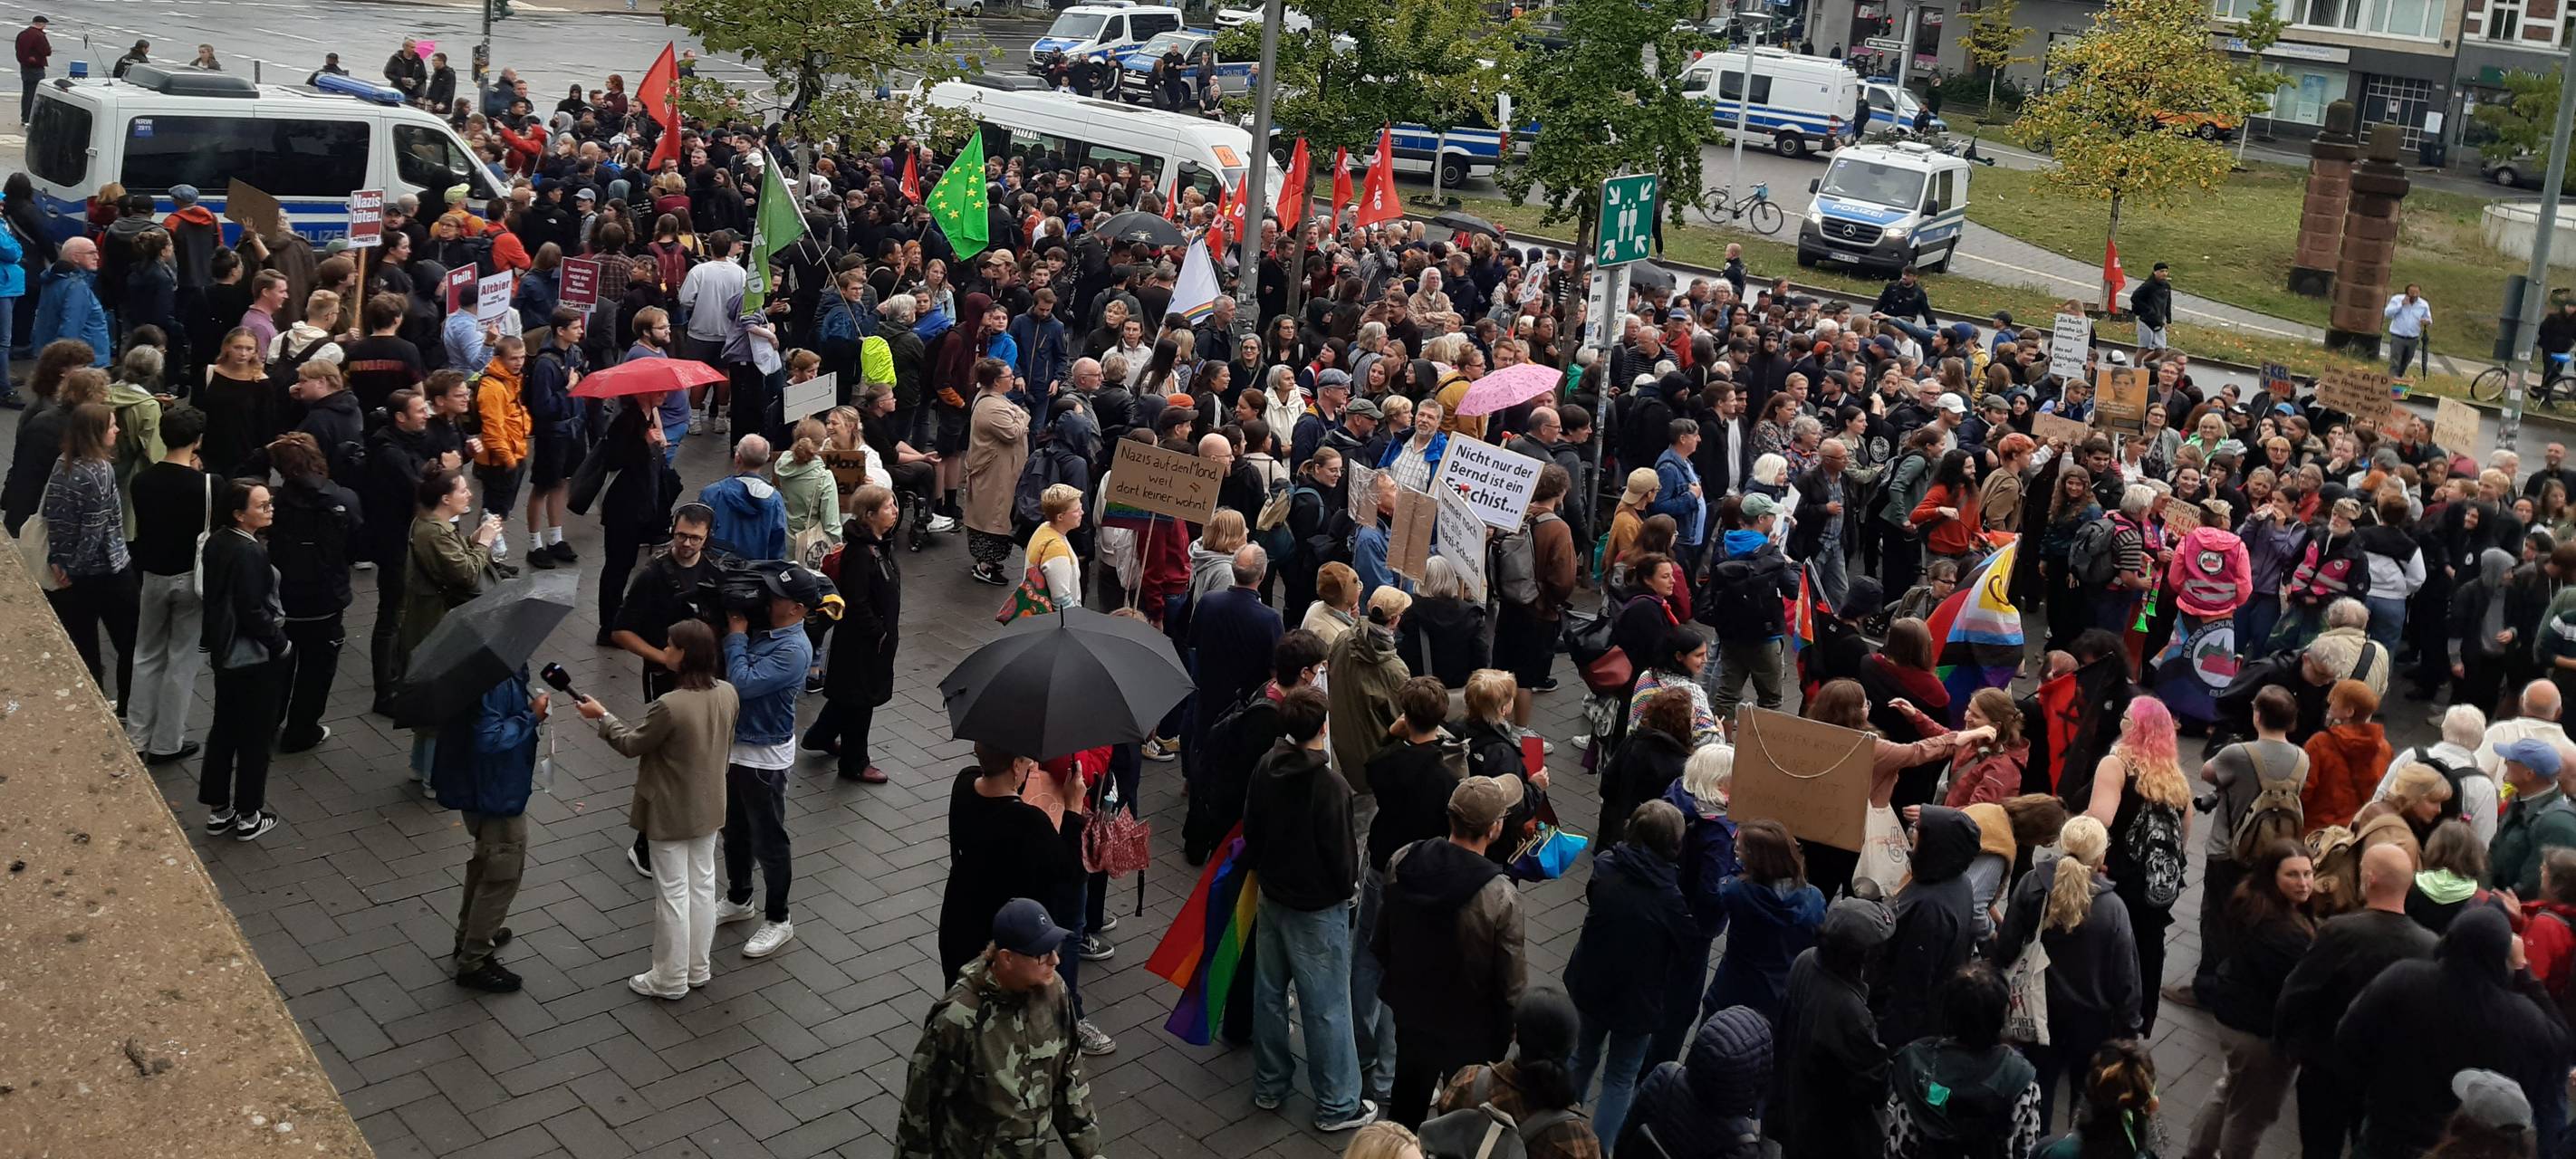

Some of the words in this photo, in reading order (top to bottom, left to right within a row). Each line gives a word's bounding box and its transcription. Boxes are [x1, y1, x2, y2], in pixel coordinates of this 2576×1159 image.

[1223, 69, 1243, 77] POLIZEI
[353, 192, 381, 209] Nazis
[1831, 204, 1884, 218] POLIZEI
[352, 210, 381, 224] töten.
[452, 270, 472, 286] Heilt
[480, 280, 510, 296] Altbier
[2361, 373, 2389, 393] AfD
[1120, 445, 1151, 465] Nazis
[1153, 455, 1171, 471] auf
[1171, 460, 1188, 474] den
[1188, 461, 1218, 483] Mond,
[1455, 444, 1490, 467] Nicht
[1491, 458, 1513, 474] nur
[1513, 463, 1533, 479] der
[1149, 474, 1174, 489] weil
[1449, 460, 1490, 484] Bernd
[1489, 472, 1505, 489] ist
[1505, 479, 1523, 494] ein
[1116, 481, 1140, 497] dort
[1142, 485, 1173, 504] keiner
[1175, 493, 1207, 512] wohnt
[1445, 476, 1519, 515] Fachist...
[1440, 510, 1450, 524] die
[1450, 520, 1463, 540] alte
[1441, 492, 1462, 520] Immer
[1462, 516, 1478, 541] noch
[1439, 523, 1480, 578] Nazi-Scheiße
